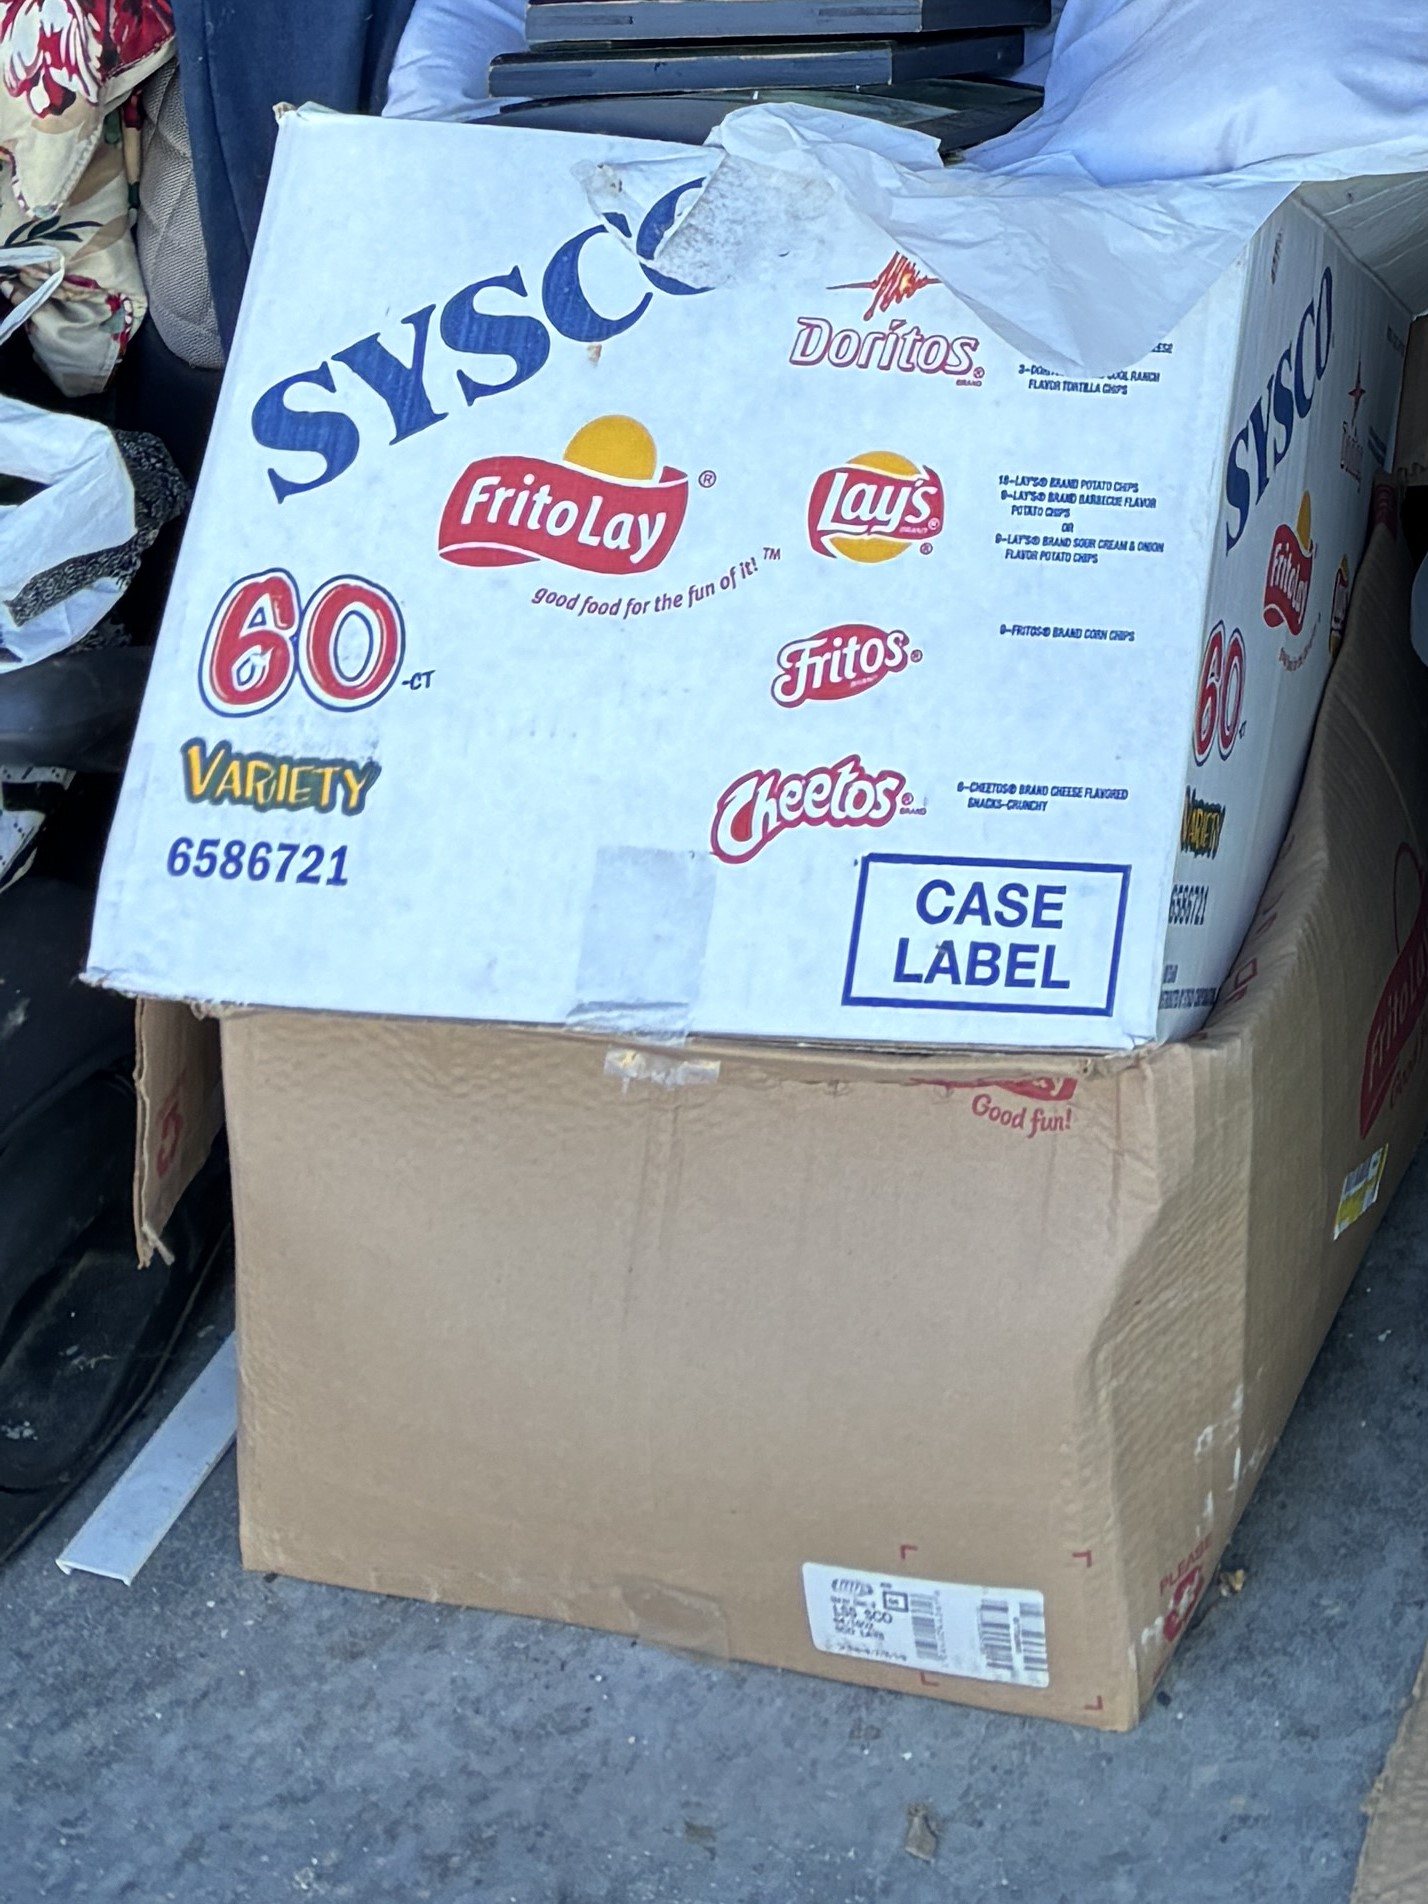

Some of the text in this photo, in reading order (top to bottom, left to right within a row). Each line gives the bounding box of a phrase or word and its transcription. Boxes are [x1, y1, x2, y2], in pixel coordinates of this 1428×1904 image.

[1029, 379, 1061, 391] FLAVOR
[1102, 383, 1128, 395] CHIPS
[1225, 265, 1333, 557] SYSCO
[816, 471, 939, 537] Lay's
[1080, 479, 1112, 491] POTATO
[1113, 481, 1139, 493] CHIPS
[531, 586, 581, 611] good
[577, 594, 620, 617] food
[622, 597, 652, 620] for
[654, 591, 683, 613] the
[686, 581, 716, 609] fun
[718, 566, 738, 592] of
[197, 567, 406, 718] 60
[773, 629, 909, 706] Fritos
[1193, 619, 1248, 767] 60
[180, 736, 382, 817] VARIETY
[714, 757, 905, 863] Cheetos
[166, 836, 349, 887] 6586721
[915, 878, 1067, 930] CASE
[892, 936, 1072, 990] LABEL
[972, 1093, 1072, 1139] Good fun!
